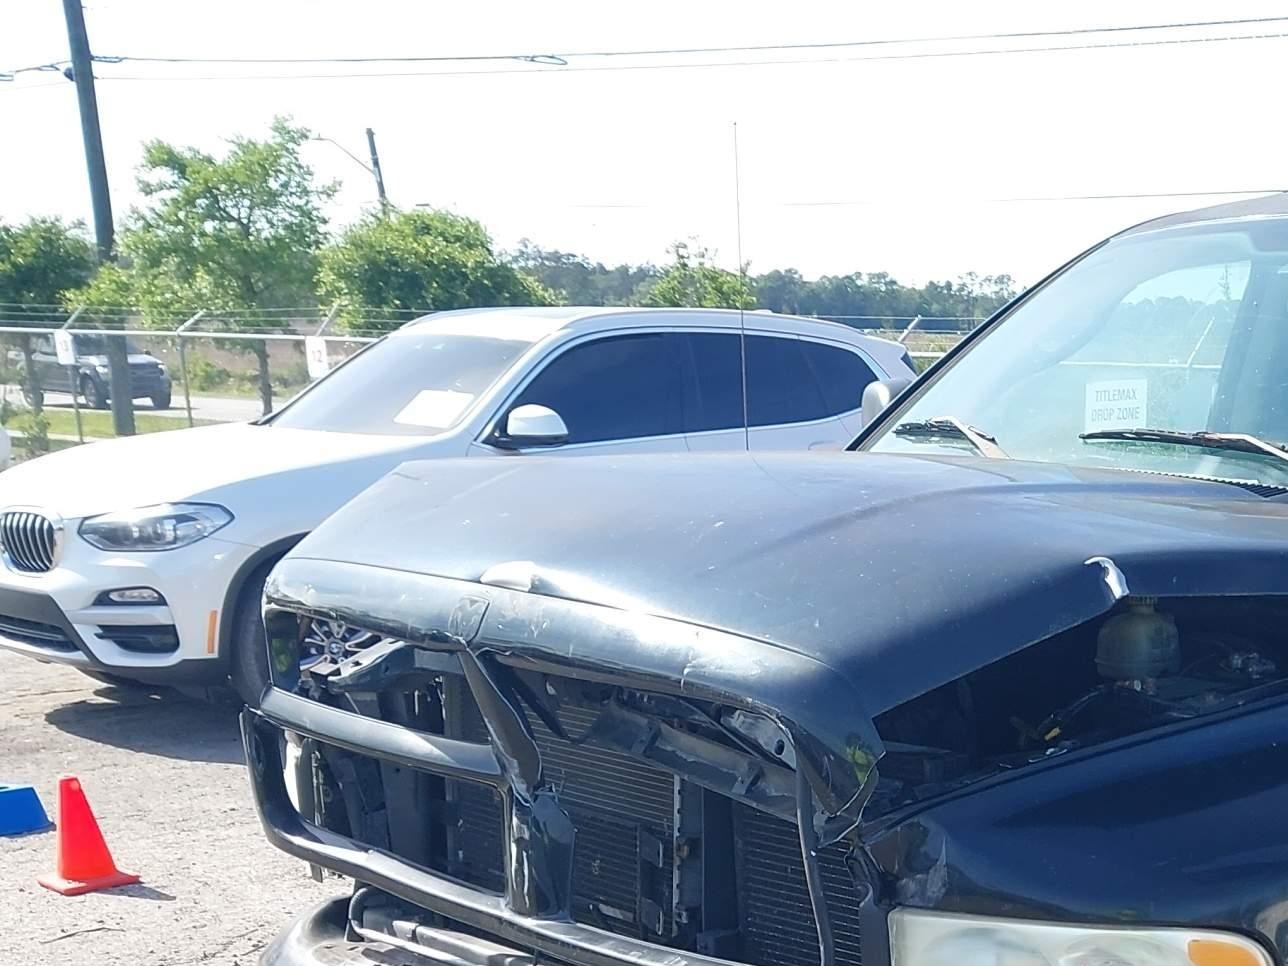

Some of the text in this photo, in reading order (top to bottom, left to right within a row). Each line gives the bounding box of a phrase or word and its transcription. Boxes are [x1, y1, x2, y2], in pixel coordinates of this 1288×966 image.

[1095, 388, 1138, 402] TITLEMAX
[1091, 406, 1141, 422] DROP ZONE
